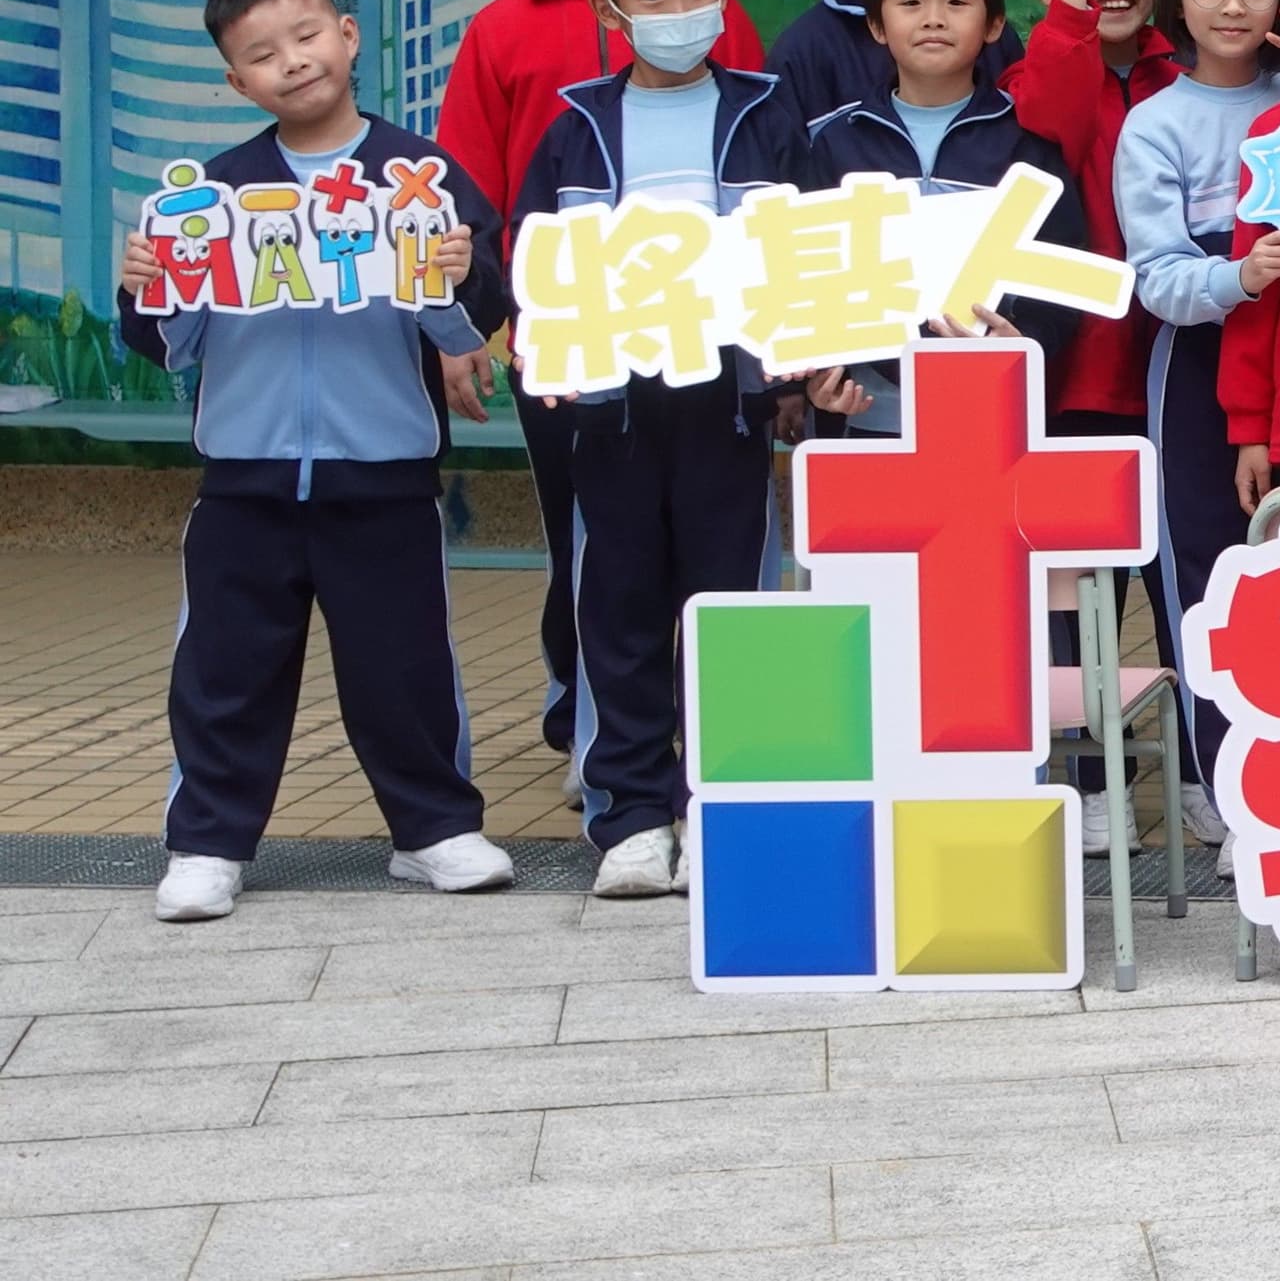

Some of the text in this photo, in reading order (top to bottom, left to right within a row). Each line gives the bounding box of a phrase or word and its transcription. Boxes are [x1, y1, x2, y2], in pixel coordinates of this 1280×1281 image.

[137, 225, 446, 308] MATH
[524, 175, 1130, 386] 將基人
